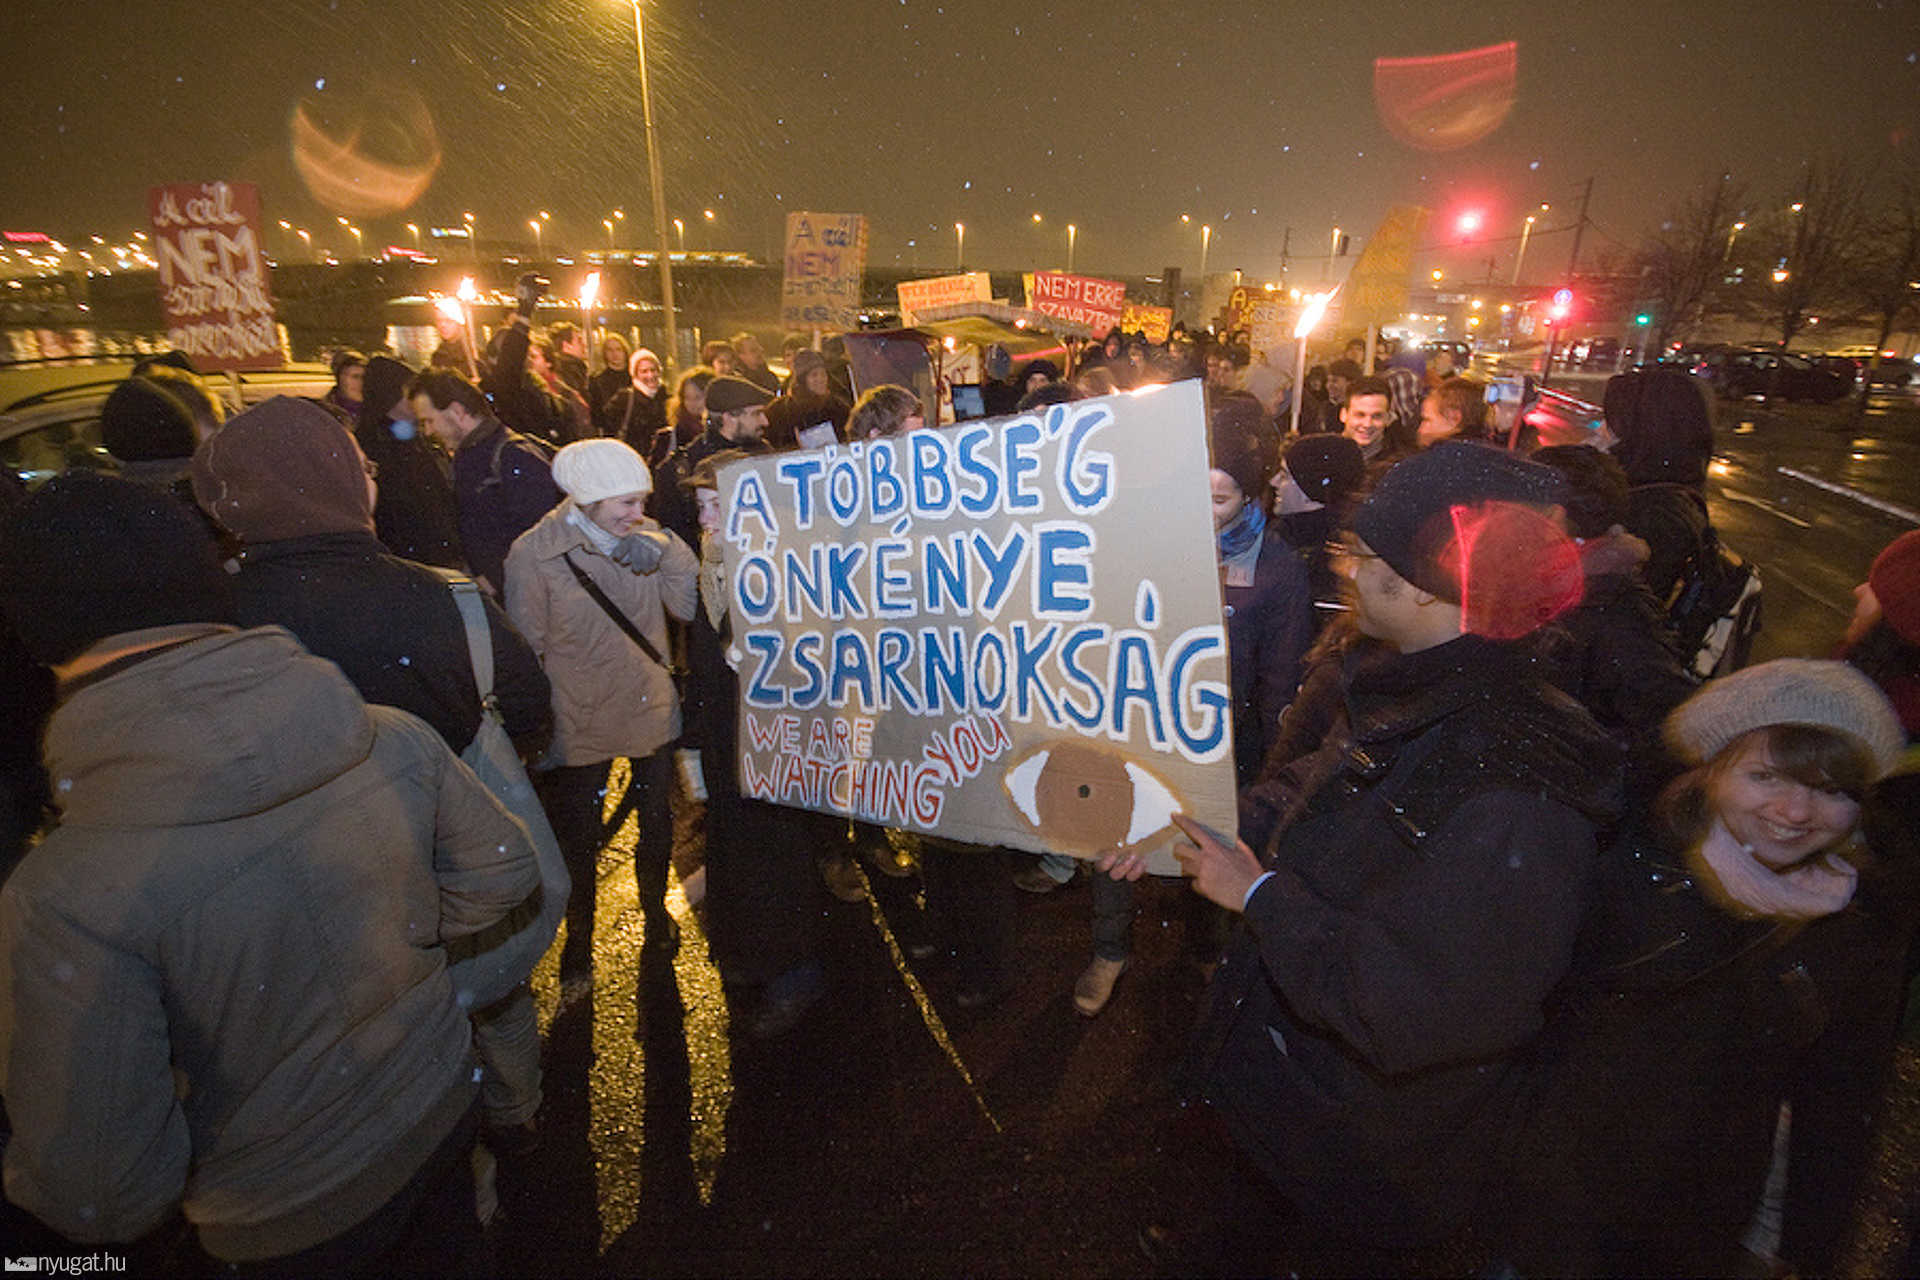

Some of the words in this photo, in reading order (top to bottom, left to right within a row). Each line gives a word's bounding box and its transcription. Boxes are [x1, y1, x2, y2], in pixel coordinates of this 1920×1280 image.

[157, 225, 264, 288] NEM
[1036, 275, 1081, 301] NEM
[1083, 280, 1126, 311] ERRE
[726, 470, 780, 542] A
[744, 580, 1232, 764] ZSARNOKSÁG
[742, 754, 945, 829] WATCHING
[925, 709, 1013, 788] YOU
[746, 714, 800, 756] WE
[807, 718, 878, 760] ARE
